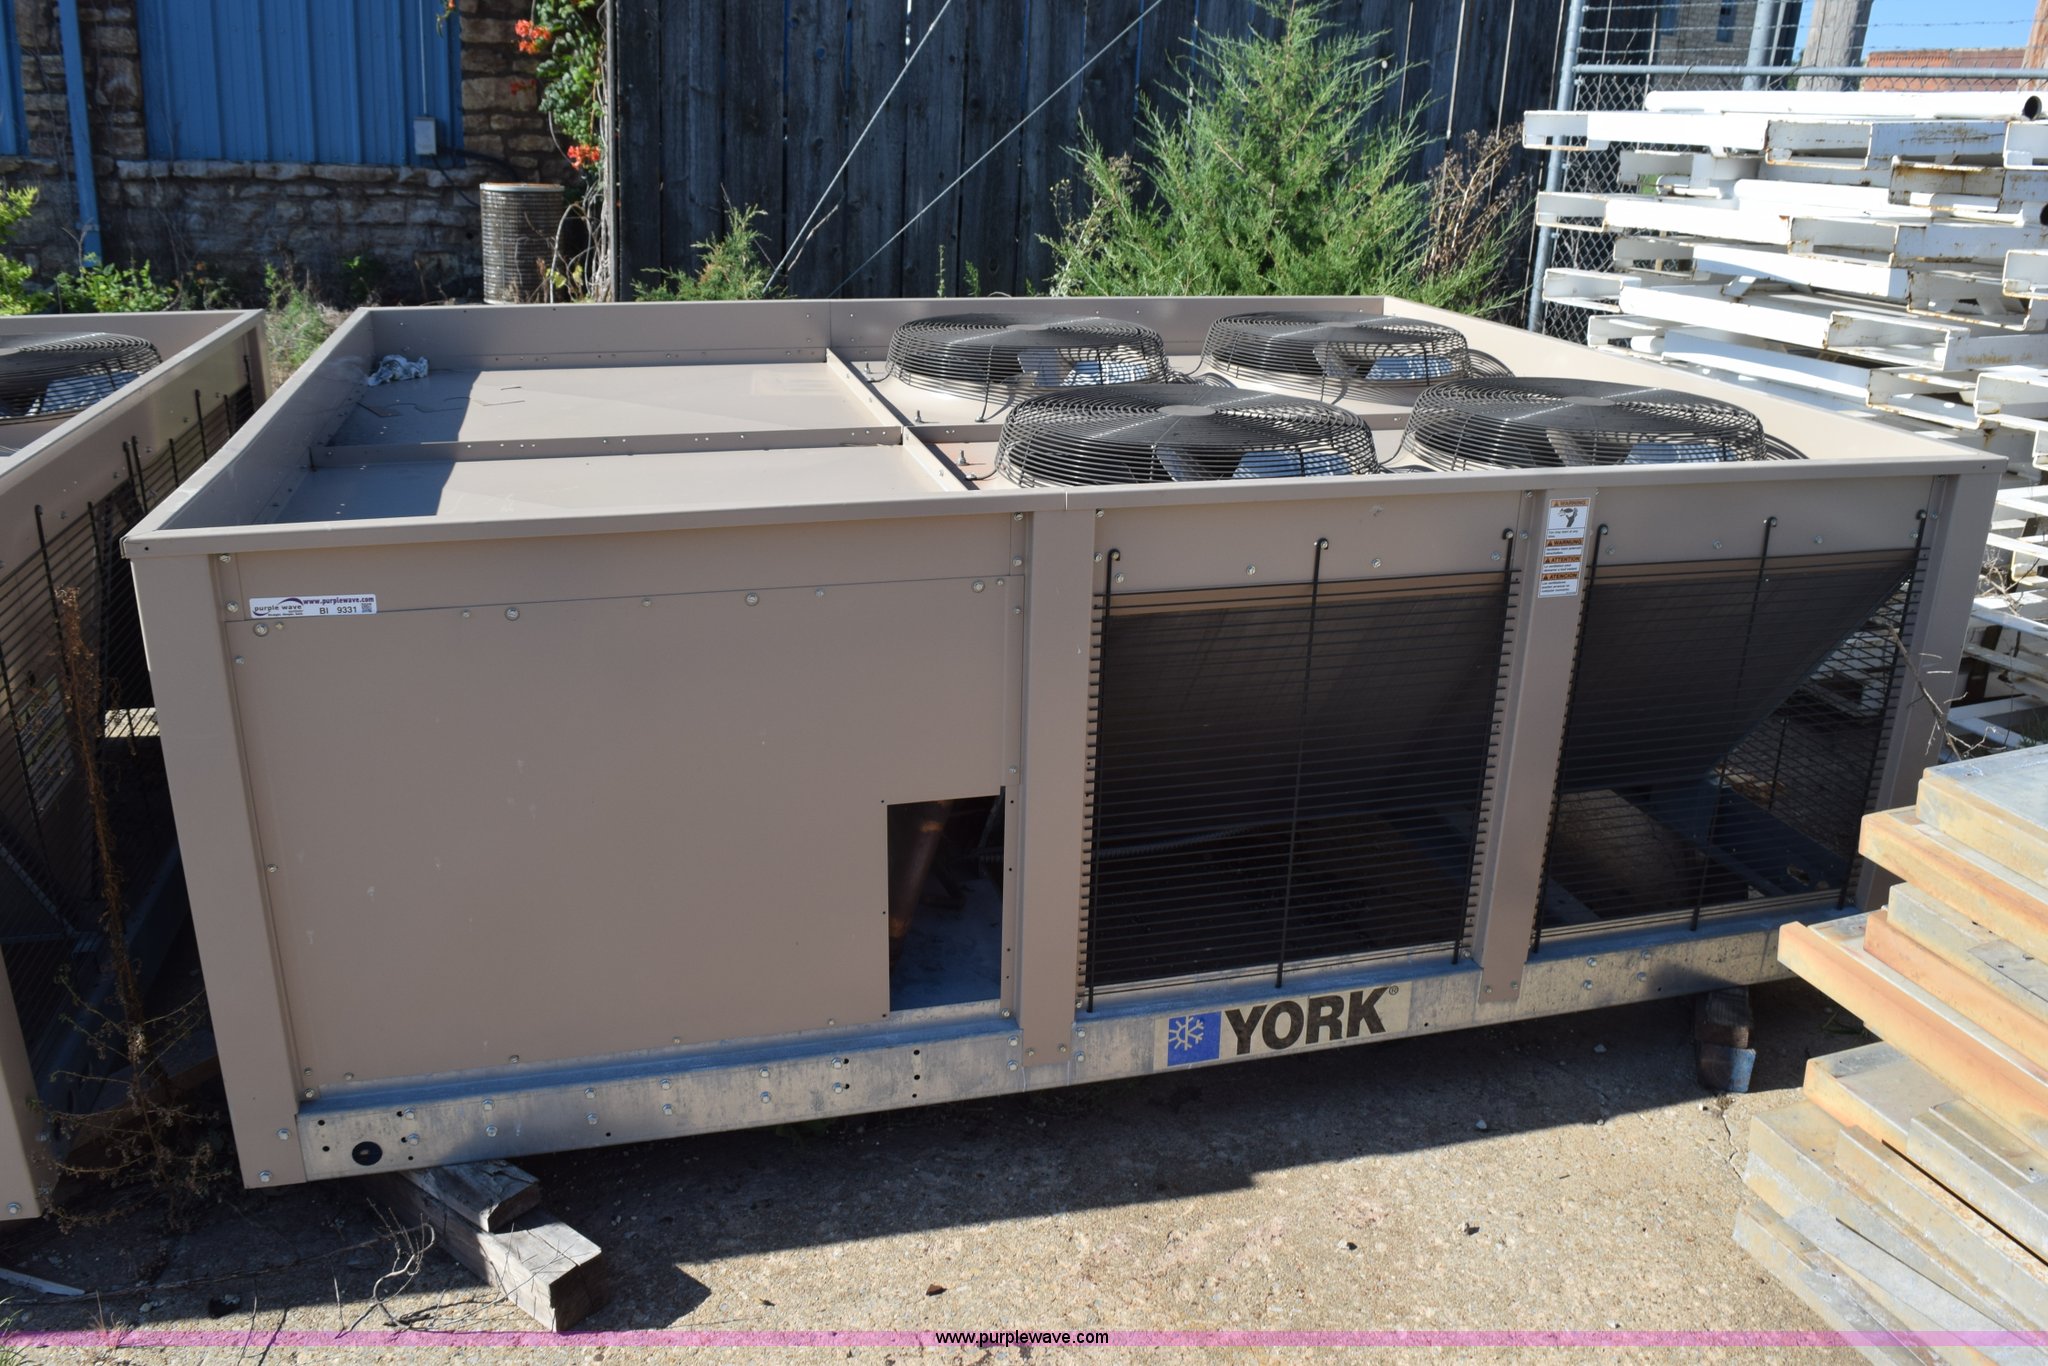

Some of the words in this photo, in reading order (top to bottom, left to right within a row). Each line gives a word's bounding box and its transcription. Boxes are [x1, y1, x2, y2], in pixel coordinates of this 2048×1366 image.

[303, 597, 375, 605] www.purplewave.com
[337, 606, 357, 614] 9331
[1225, 986, 1390, 1055] YORK
